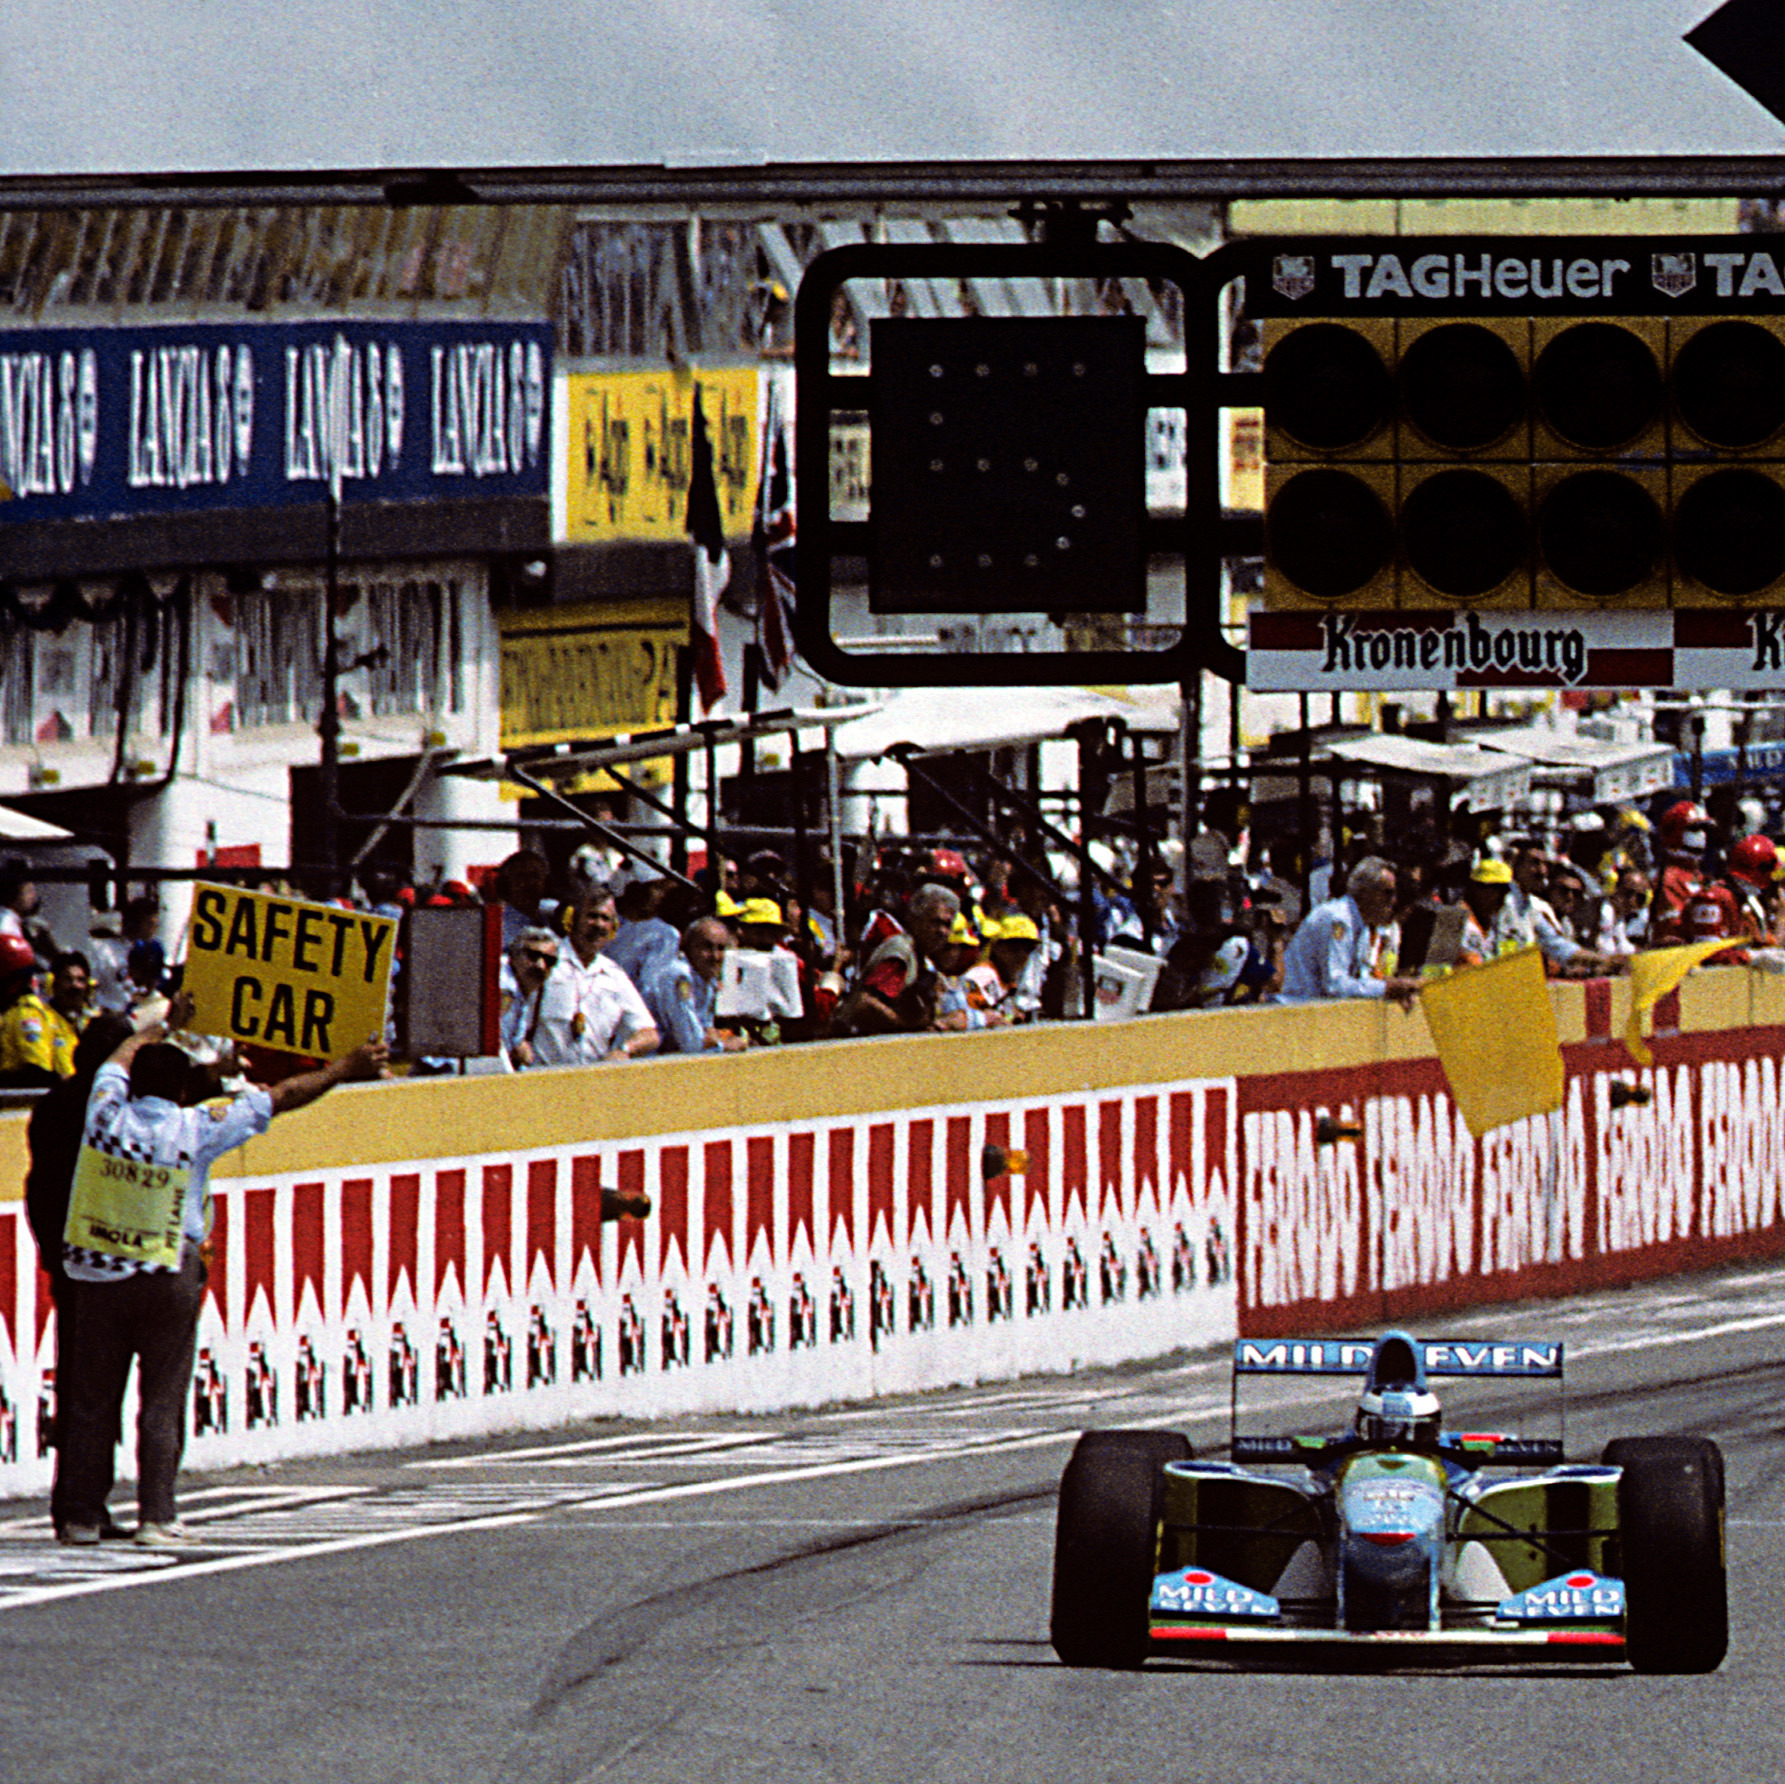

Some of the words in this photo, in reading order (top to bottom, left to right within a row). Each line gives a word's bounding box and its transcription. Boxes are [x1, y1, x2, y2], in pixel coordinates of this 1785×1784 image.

[1320, 612, 1587, 684] Kronenbourg
[193, 889, 390, 984] SAFETY
[231, 975, 335, 1053] CAR
[101, 1158, 170, 1188] 30829
[89, 1225, 144, 1248] IMOLA
[1425, 1345, 1557, 1367] EVEN
[1158, 1584, 1254, 1603] MILD
[1524, 1588, 1620, 1605] MILD
